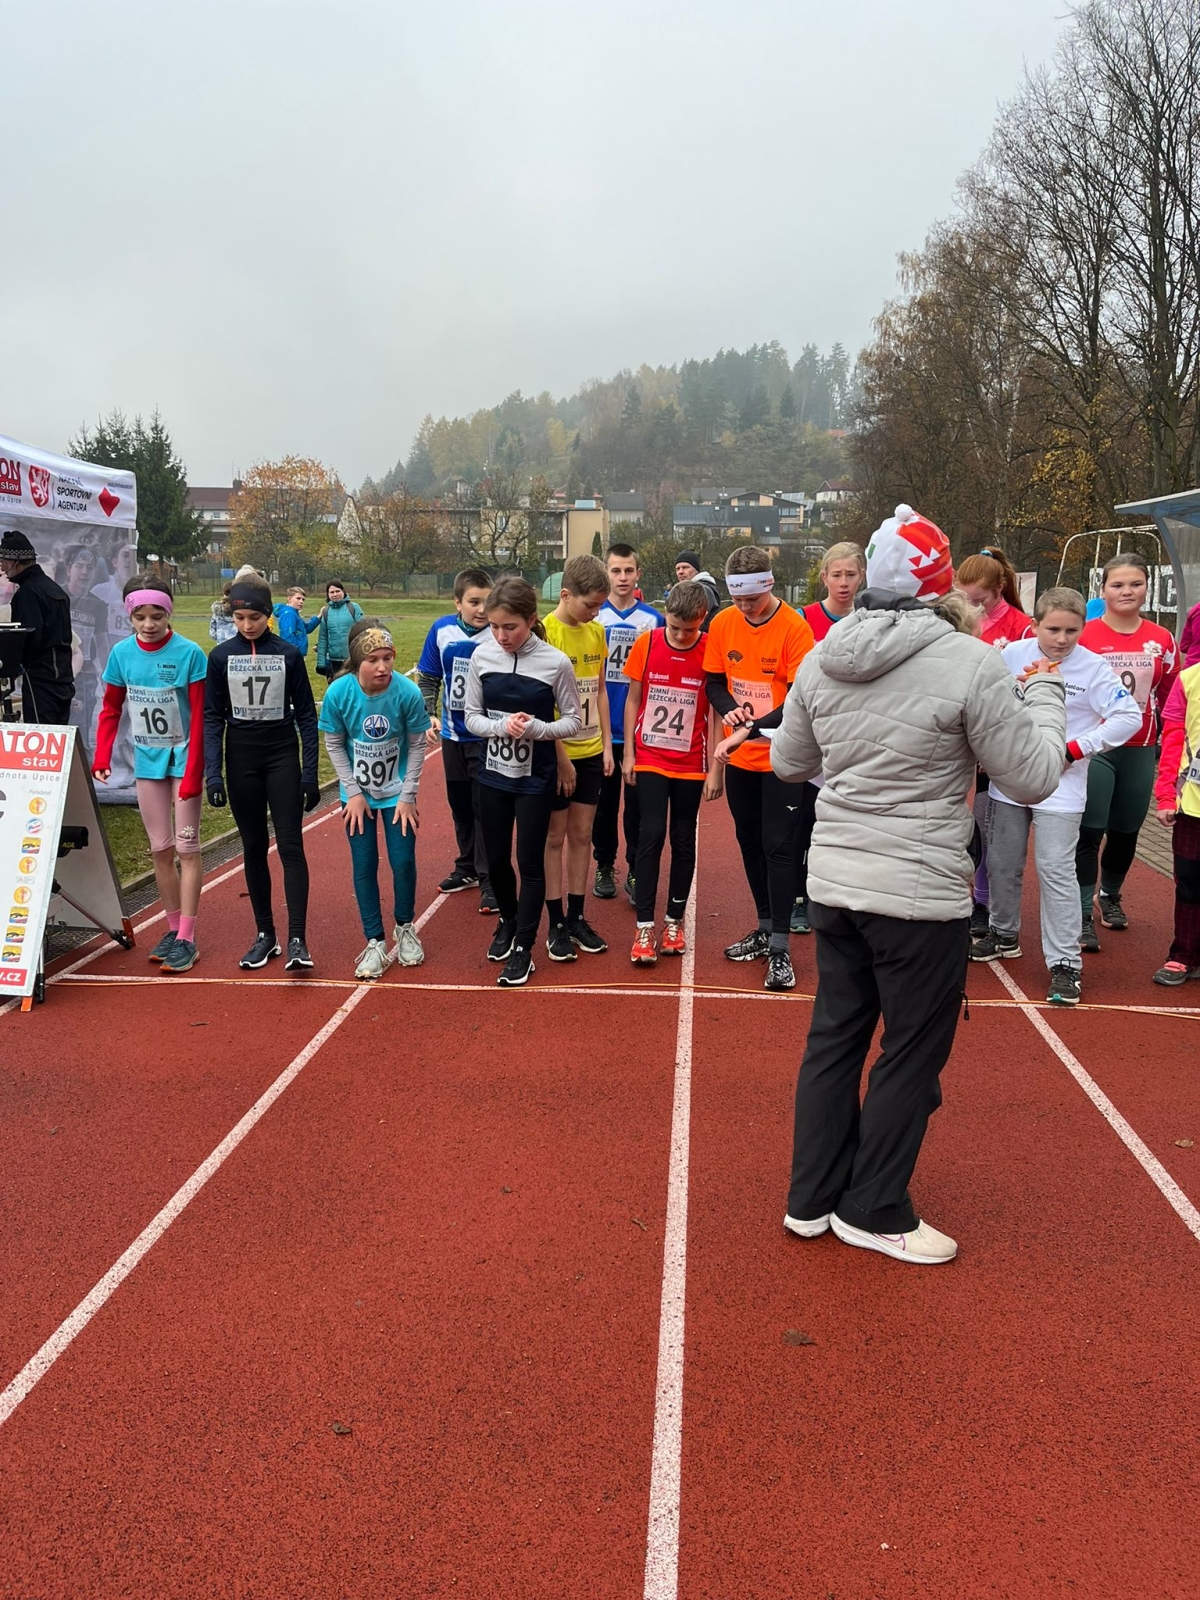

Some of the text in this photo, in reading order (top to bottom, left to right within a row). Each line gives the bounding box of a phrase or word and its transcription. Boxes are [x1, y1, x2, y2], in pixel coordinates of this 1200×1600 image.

[1, 482, 18, 492] stav
[57, 486, 92, 500] SPORTOVNÍ
[57, 500, 87, 512] AGENTURA
[229, 664, 262, 672] BĚŽECKÁ
[129, 687, 146, 696] ZIMNÍ
[242, 676, 271, 705] 17
[650, 686, 669, 695] ZIMNÍ
[755, 691, 771, 699] LIGA
[129, 694, 155, 704] BĚŽECKÁ
[648, 694, 677, 703] BĚŽECKÁ
[679, 698, 695, 706] LIGA
[140, 707, 168, 735] 16
[651, 705, 684, 736] 24
[355, 742, 373, 751] ZIMNÍ
[355, 749, 382, 758] BĚŽECKÁ
[385, 745, 398, 756] LIGA
[489, 737, 530, 763] 386
[22, 757, 58, 768] stav
[33, 771, 60, 782] Úpice
[356, 755, 397, 787] 397
